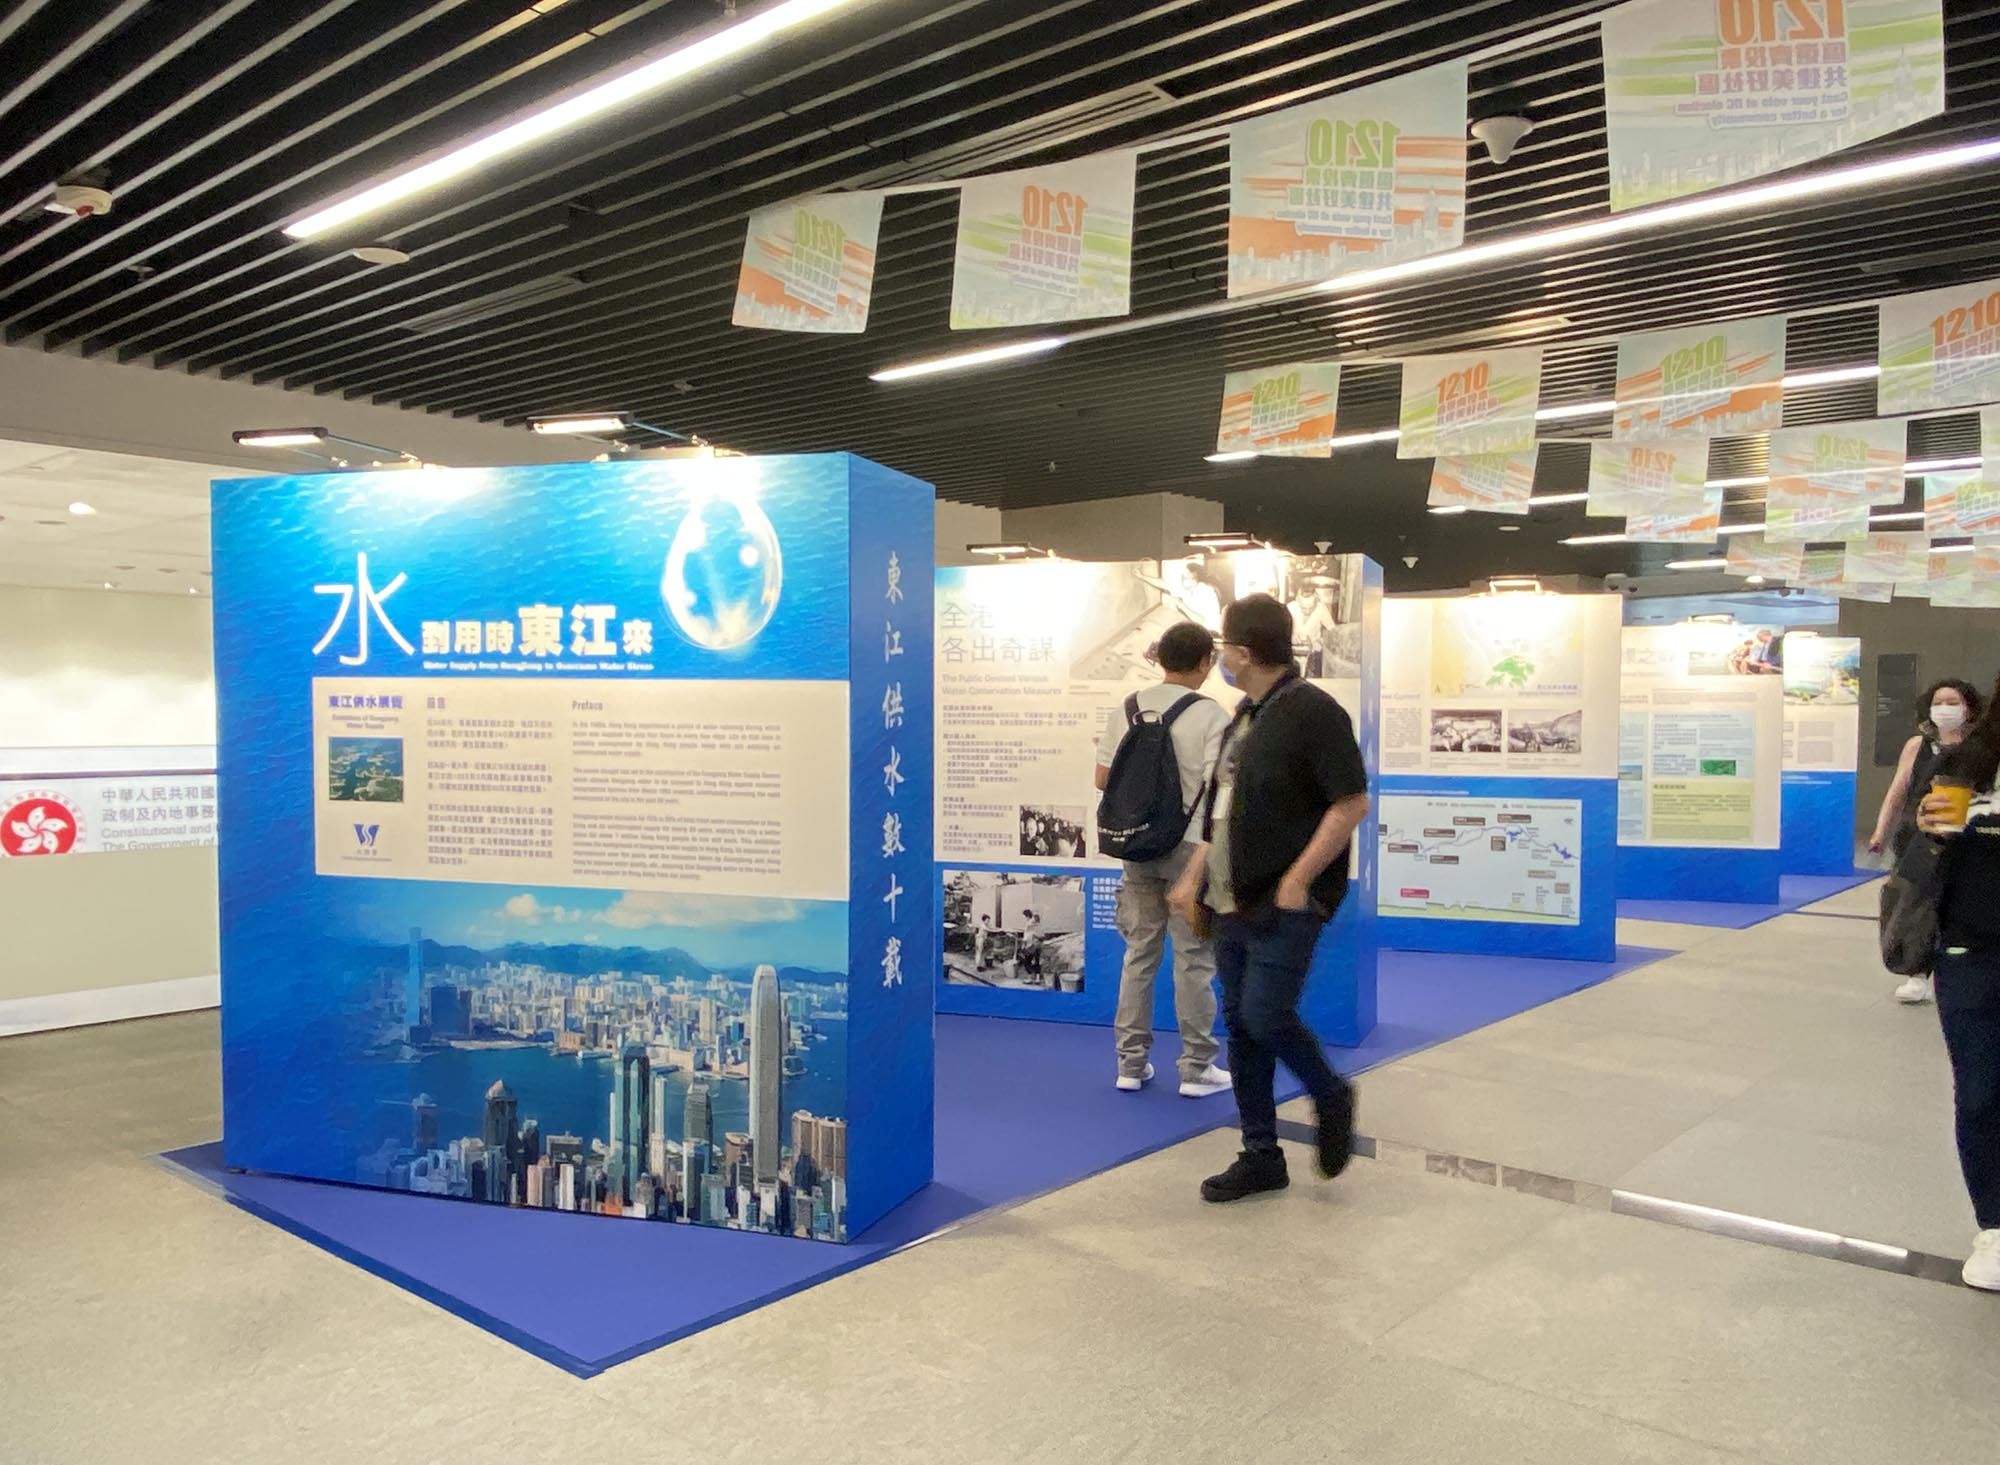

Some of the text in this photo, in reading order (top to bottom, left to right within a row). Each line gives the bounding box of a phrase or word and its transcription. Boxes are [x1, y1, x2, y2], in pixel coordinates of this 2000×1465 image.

[1659, 335, 1724, 383] 1210
[1252, 372, 1299, 405] 1210
[1436, 361, 1489, 404] 1210
[572, 700, 603, 711] Preface
[881, 550, 906, 990] 東江供水數十載
[102, 786, 215, 802] 中華人民共和國
[102, 804, 215, 822] 政制及內地事務
[101, 824, 211, 839] Constitutional and
[102, 841, 125, 852] The
[128, 838, 200, 852] Government
